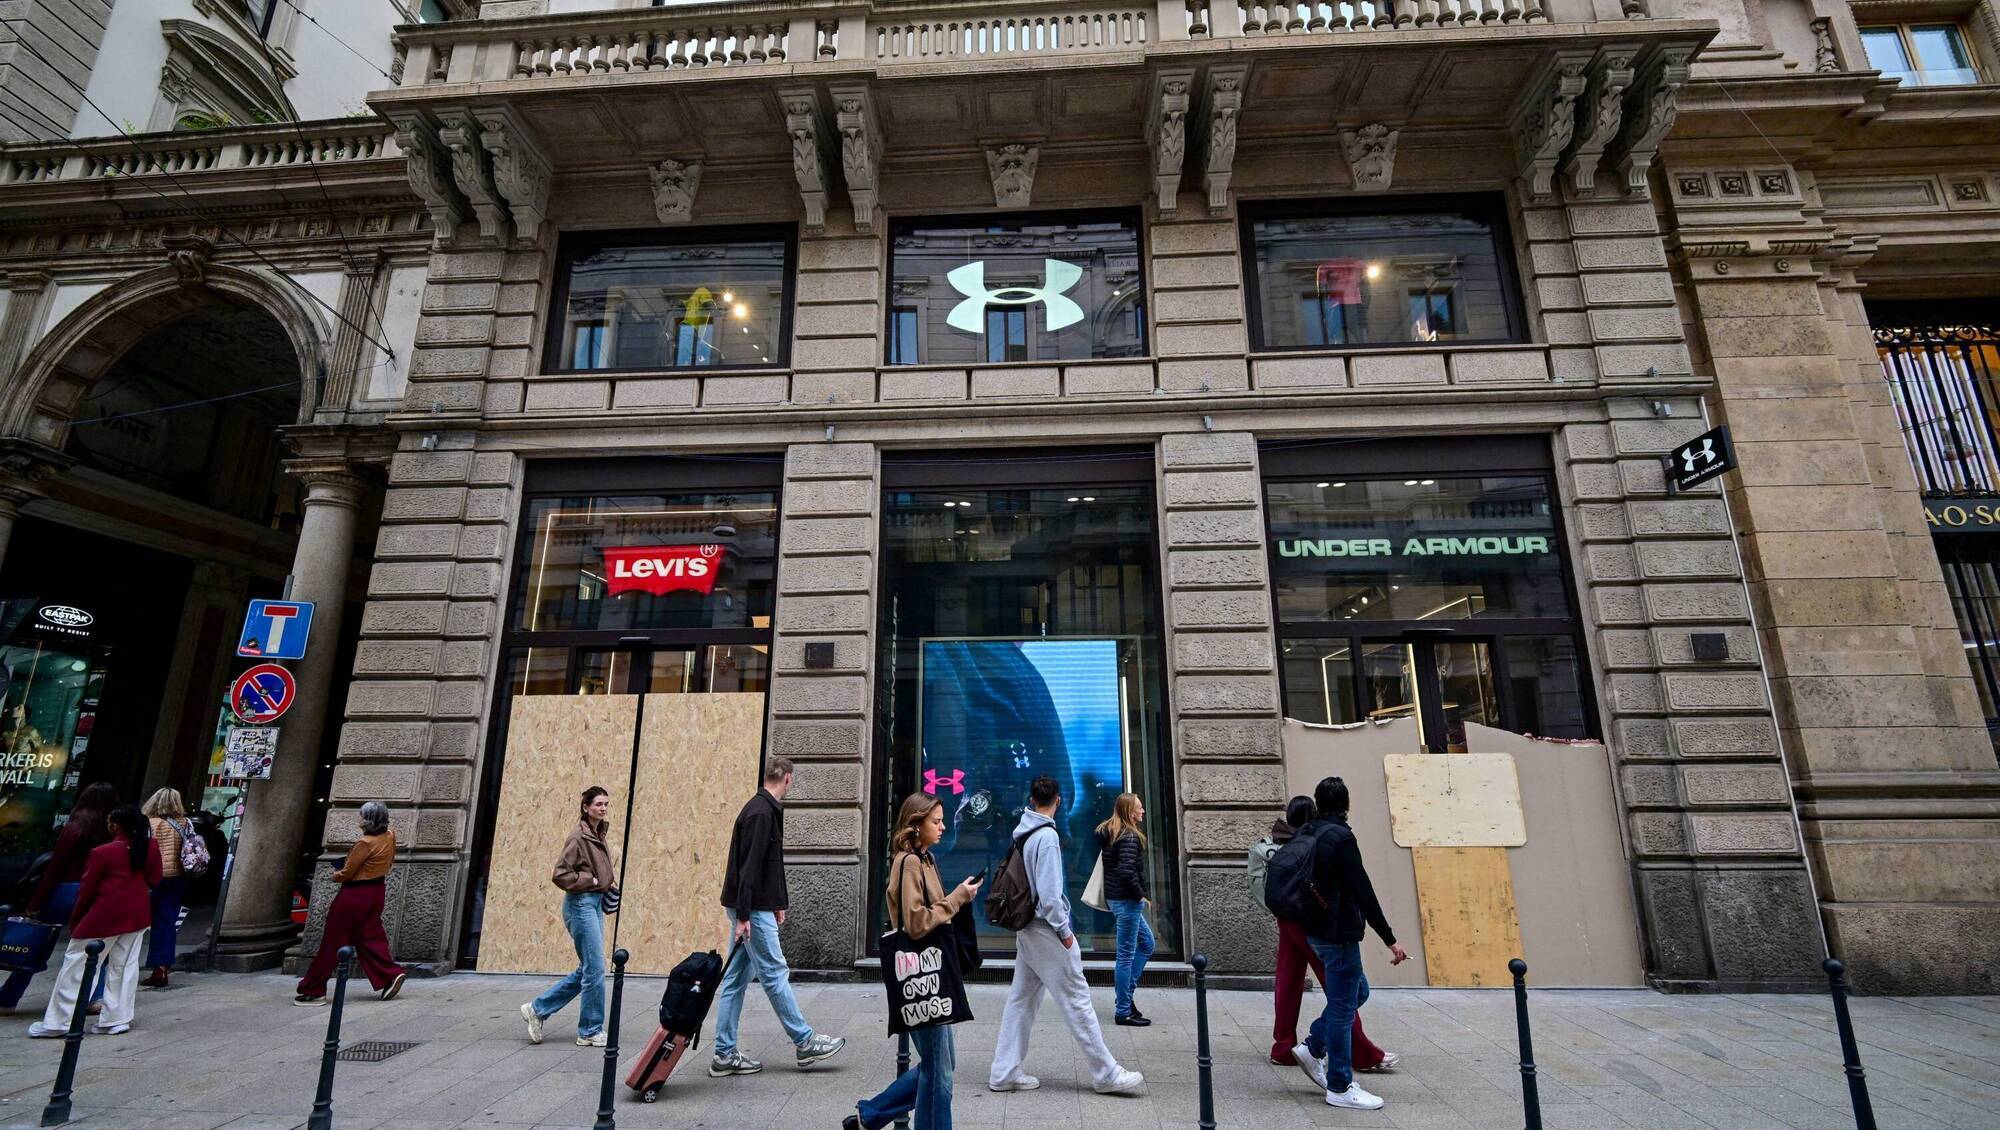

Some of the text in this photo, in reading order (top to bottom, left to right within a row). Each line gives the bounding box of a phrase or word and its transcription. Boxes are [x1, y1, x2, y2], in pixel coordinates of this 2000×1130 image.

[1681, 472, 1700, 484] UNDER
[1279, 536, 1549, 557] UNDER ARMOUR
[44, 609, 89, 623] EASTPAK
[34, 623, 54, 631] BUILT
[38, 753, 54, 768] IS
[921, 949, 939, 969] MY
[904, 974, 937, 997] OWN
[903, 998, 950, 1024] MUSE
